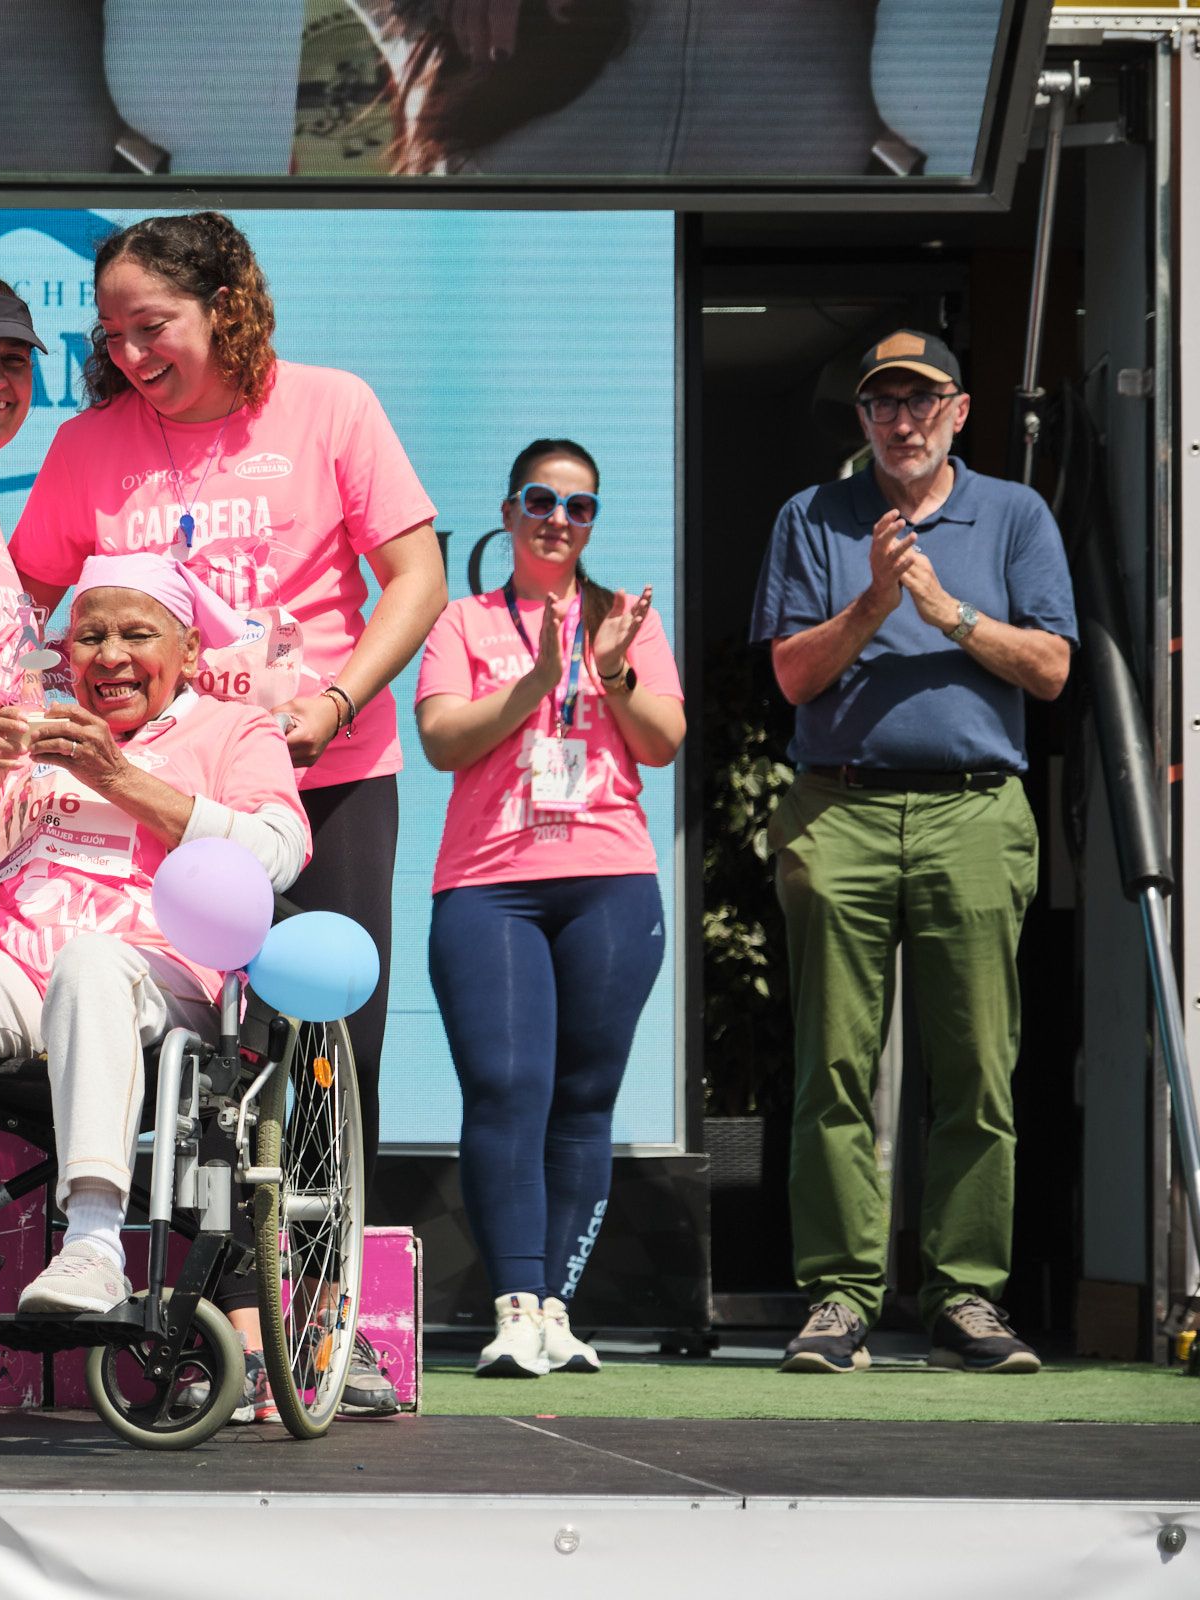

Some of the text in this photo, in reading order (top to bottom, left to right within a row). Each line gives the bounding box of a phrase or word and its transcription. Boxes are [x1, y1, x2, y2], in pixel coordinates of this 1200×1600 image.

[121, 468, 183, 491] OYSHO
[240, 463, 290, 475] ASTURIANA
[198, 671, 251, 695] 016
[29, 791, 80, 822] 016
[46, 826, 75, 842] MUJER
[80, 834, 105, 845] GIJÓN
[59, 847, 111, 866] Santander
[560, 1198, 609, 1299] adidas
